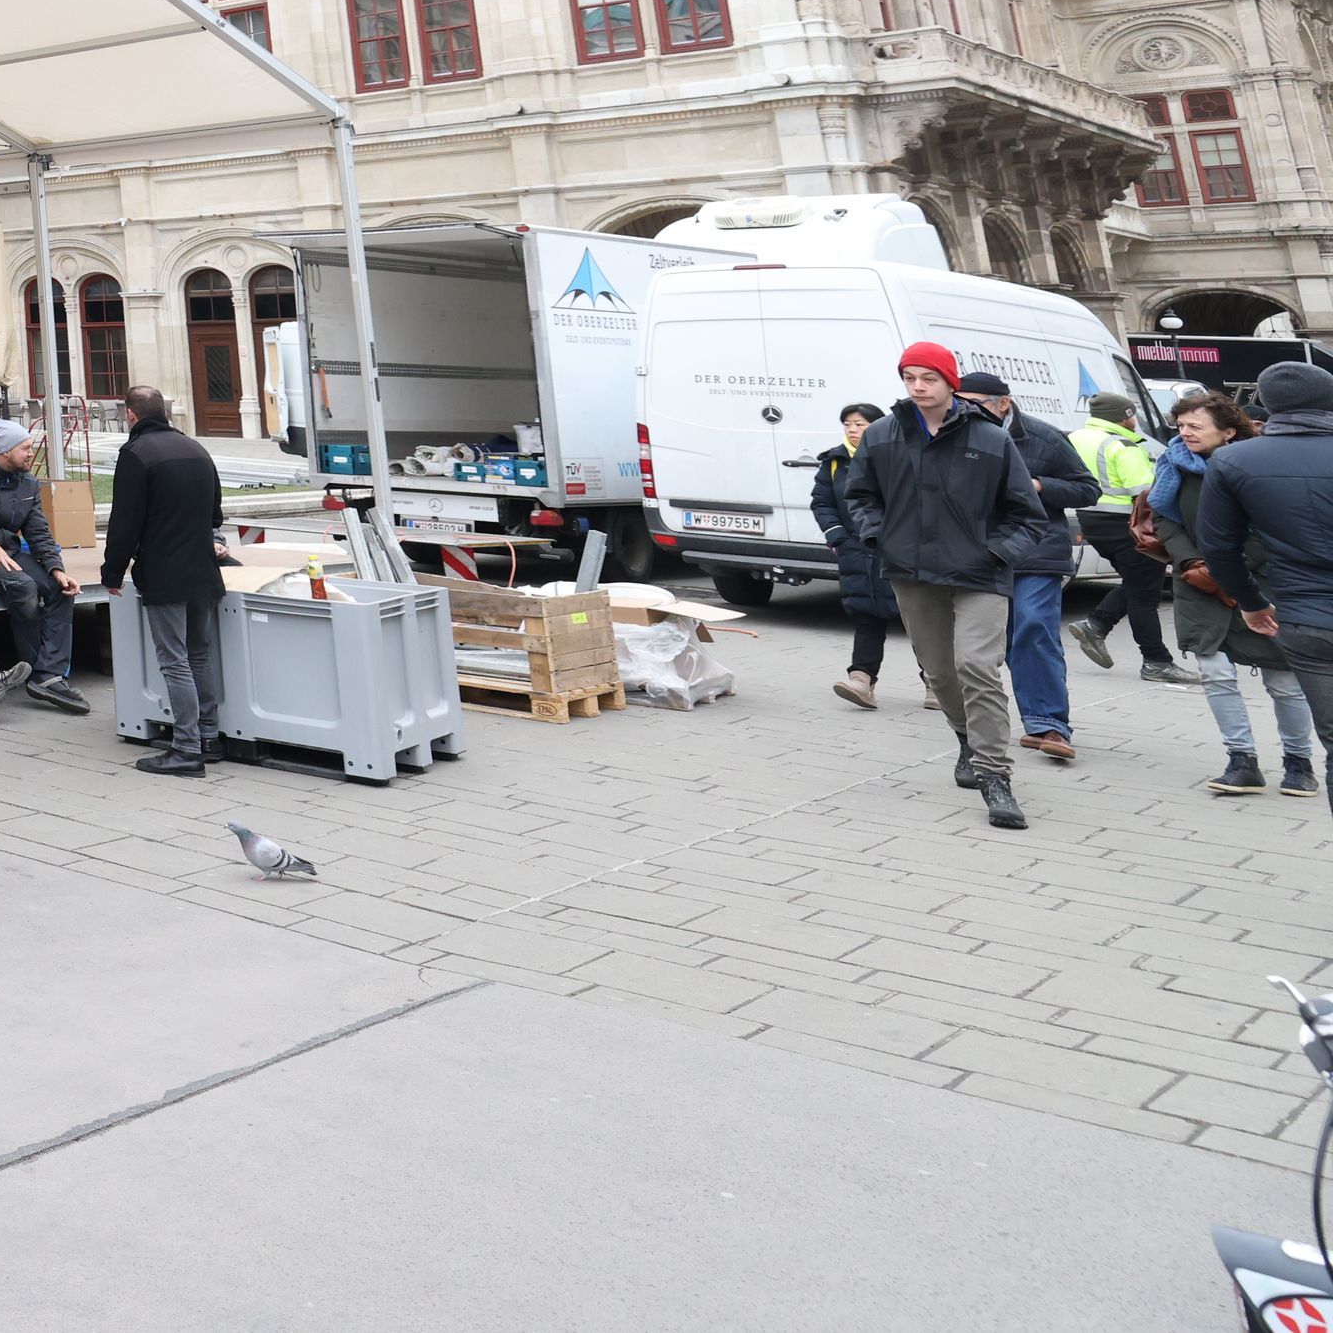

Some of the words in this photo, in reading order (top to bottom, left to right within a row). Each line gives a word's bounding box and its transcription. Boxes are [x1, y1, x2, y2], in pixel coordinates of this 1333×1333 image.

[553, 313, 573, 327] DER
[577, 315, 638, 330] OBERZELTER
[971, 352, 1055, 385] OBERZELTER
[694, 374, 721, 384] DER
[728, 375, 827, 388] OBERZELTER
[750, 390, 813, 399] EVENTSYSTEME
[565, 463, 581, 475] TÜV
[694, 514, 702, 525] W
